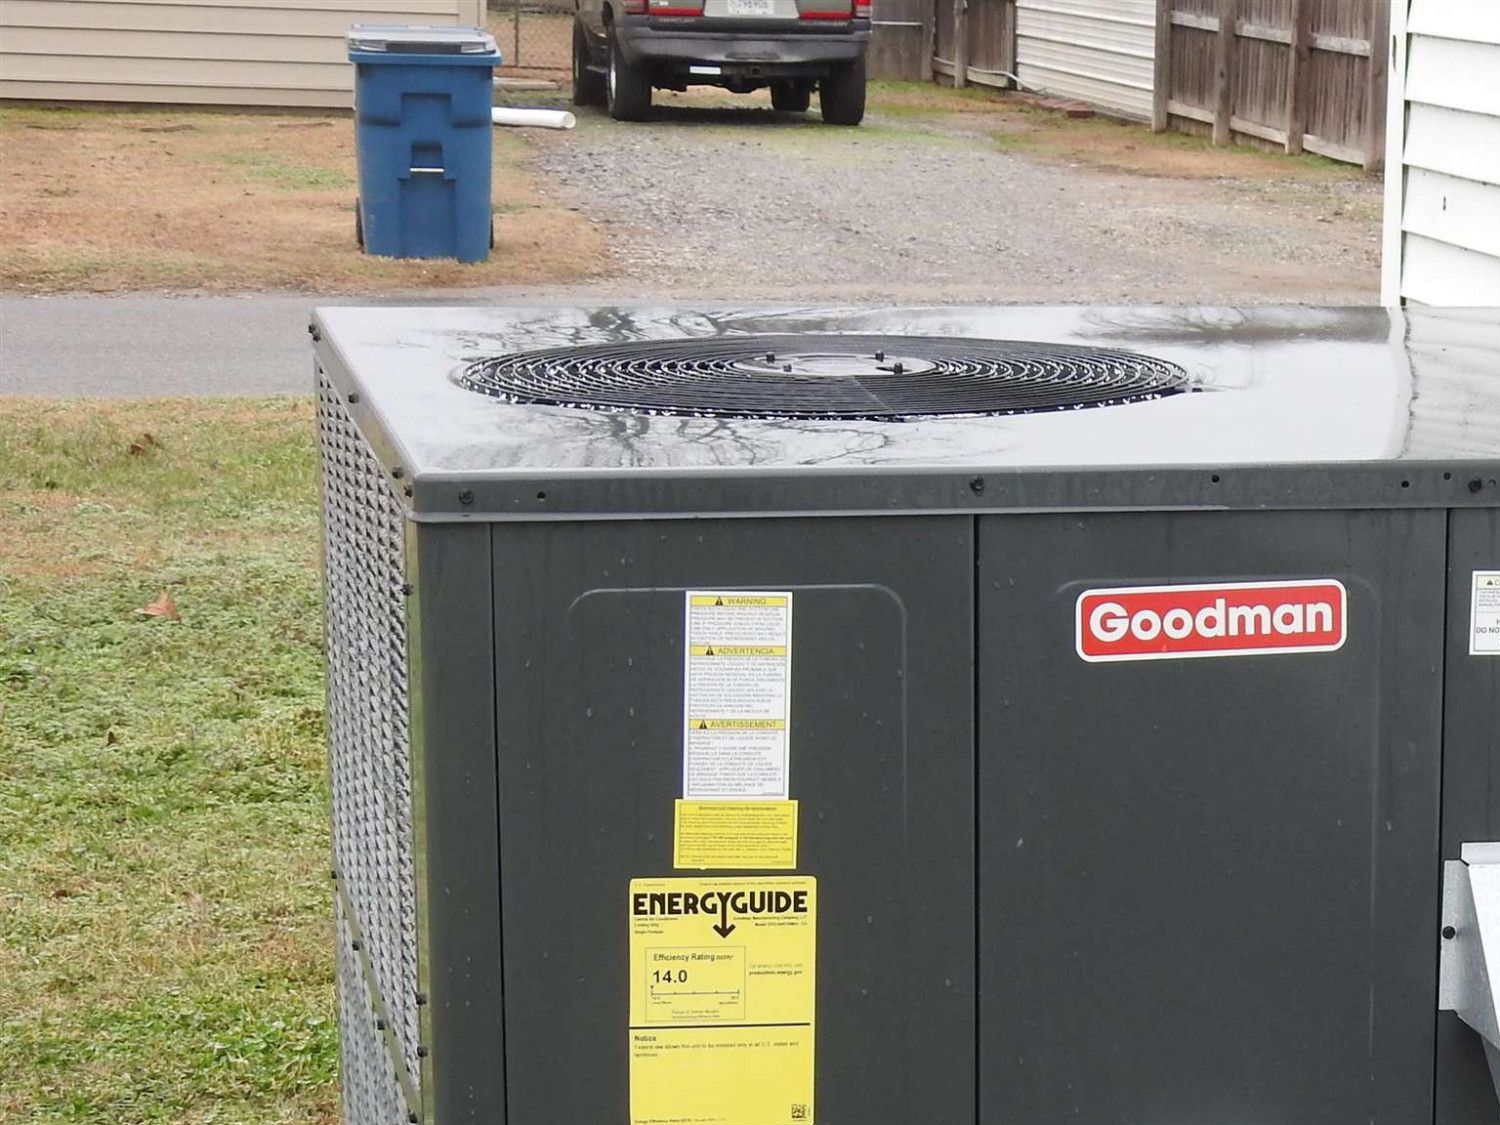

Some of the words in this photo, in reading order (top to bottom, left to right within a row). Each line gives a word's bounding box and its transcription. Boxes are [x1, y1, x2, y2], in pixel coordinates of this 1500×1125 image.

[1089, 598, 1333, 642] Goodman
[717, 647, 775, 655] ADVERTENCIA
[710, 720, 776, 728] AVERTISSEMENT
[633, 891, 808, 916] ENERGYGUIDE
[653, 953, 689, 963] Efficiency
[691, 952, 715, 963] Rating
[652, 969, 688, 984] 14.0
[634, 1034, 657, 1042] Notice
